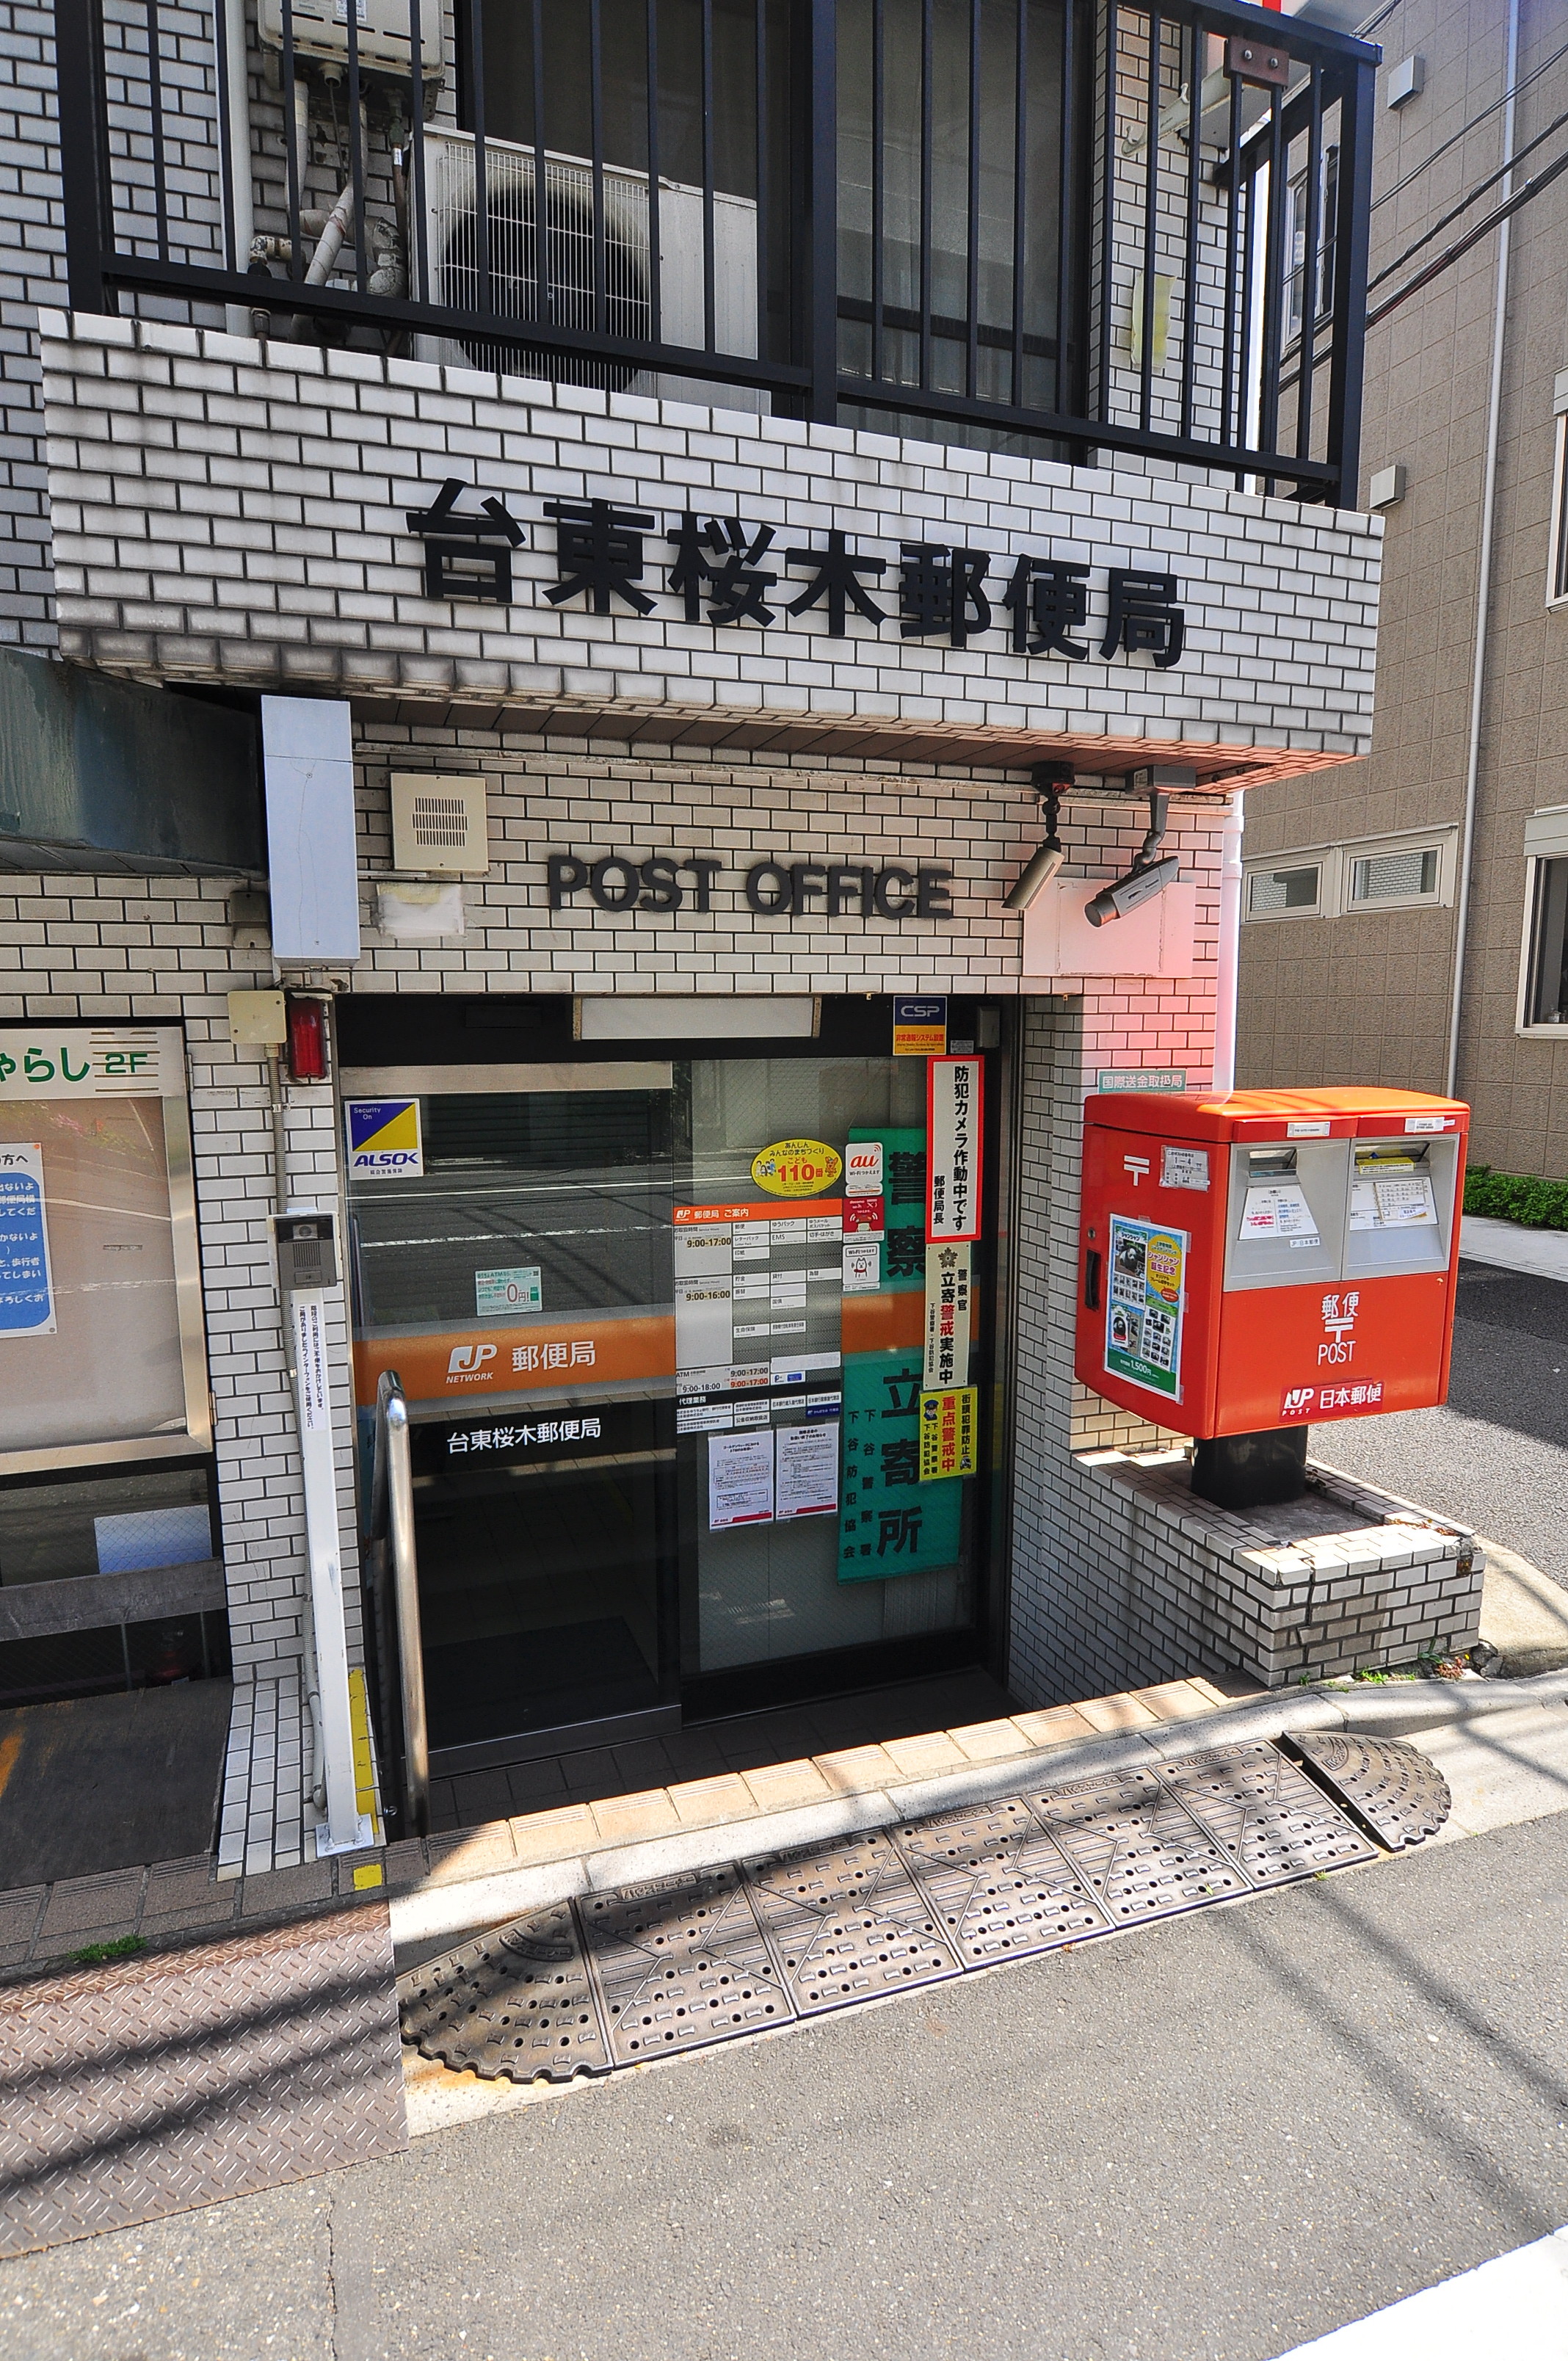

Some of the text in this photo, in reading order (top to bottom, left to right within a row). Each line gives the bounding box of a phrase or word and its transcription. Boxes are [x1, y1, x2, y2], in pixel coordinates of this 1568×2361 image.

[406, 477, 1184, 667] 台東桜木郵便局
[548, 855, 954, 919] POST OFFICE
[901, 1005, 940, 1017] CSP
[896, 1033, 944, 1042] 非常通報システム設置
[105, 1052, 148, 1073] 2F
[1102, 1075, 1183, 1089] 国際送金取扱局
[354, 1103, 381, 1113] Security
[769, 1147, 825, 1157] みんなのまちづくり
[952, 1065, 970, 1231] 防犯カメラ作動中です
[0, 1153, 29, 1166] 方へ
[353, 1152, 419, 1167] ALSOK
[850, 1155, 879, 1168] au
[777, 1164, 824, 1182] 110番
[933, 1175, 945, 1225] 郵便局長
[687, 1237, 732, 1248] 9:00-17:00
[1147, 1252, 1180, 1265] シャンシャン
[686, 1290, 731, 1302] 9:00-16:00
[957, 1269, 968, 1311] 警察官
[1321, 1291, 1360, 1321] 郵便
[939, 1272, 956, 1385] 立寄警戒実施中
[448, 1343, 498, 1374] JP
[512, 1341, 596, 1372] 郵便局
[1317, 1340, 1357, 1366] POST
[446, 1371, 494, 1384] NETWORK
[675, 1371, 690, 1379] ATM
[730, 1367, 769, 1377] 9:00-17:00
[682, 1382, 721, 1393] 9:00-18:00
[730, 1377, 769, 1388] 9:00-17:00
[1283, 1383, 1383, 1410] JP 日本郵便
[1281, 1407, 1311, 1416] POST
[961, 1393, 971, 1455] 街頭犯罪防止
[446, 1418, 602, 1454] 台東桜木郵便局
[942, 1396, 957, 1473] 重点警戒中
[843, 1410, 860, 1559] 下谷防犯協会
[860, 1408, 876, 1557] 下谷警察署
